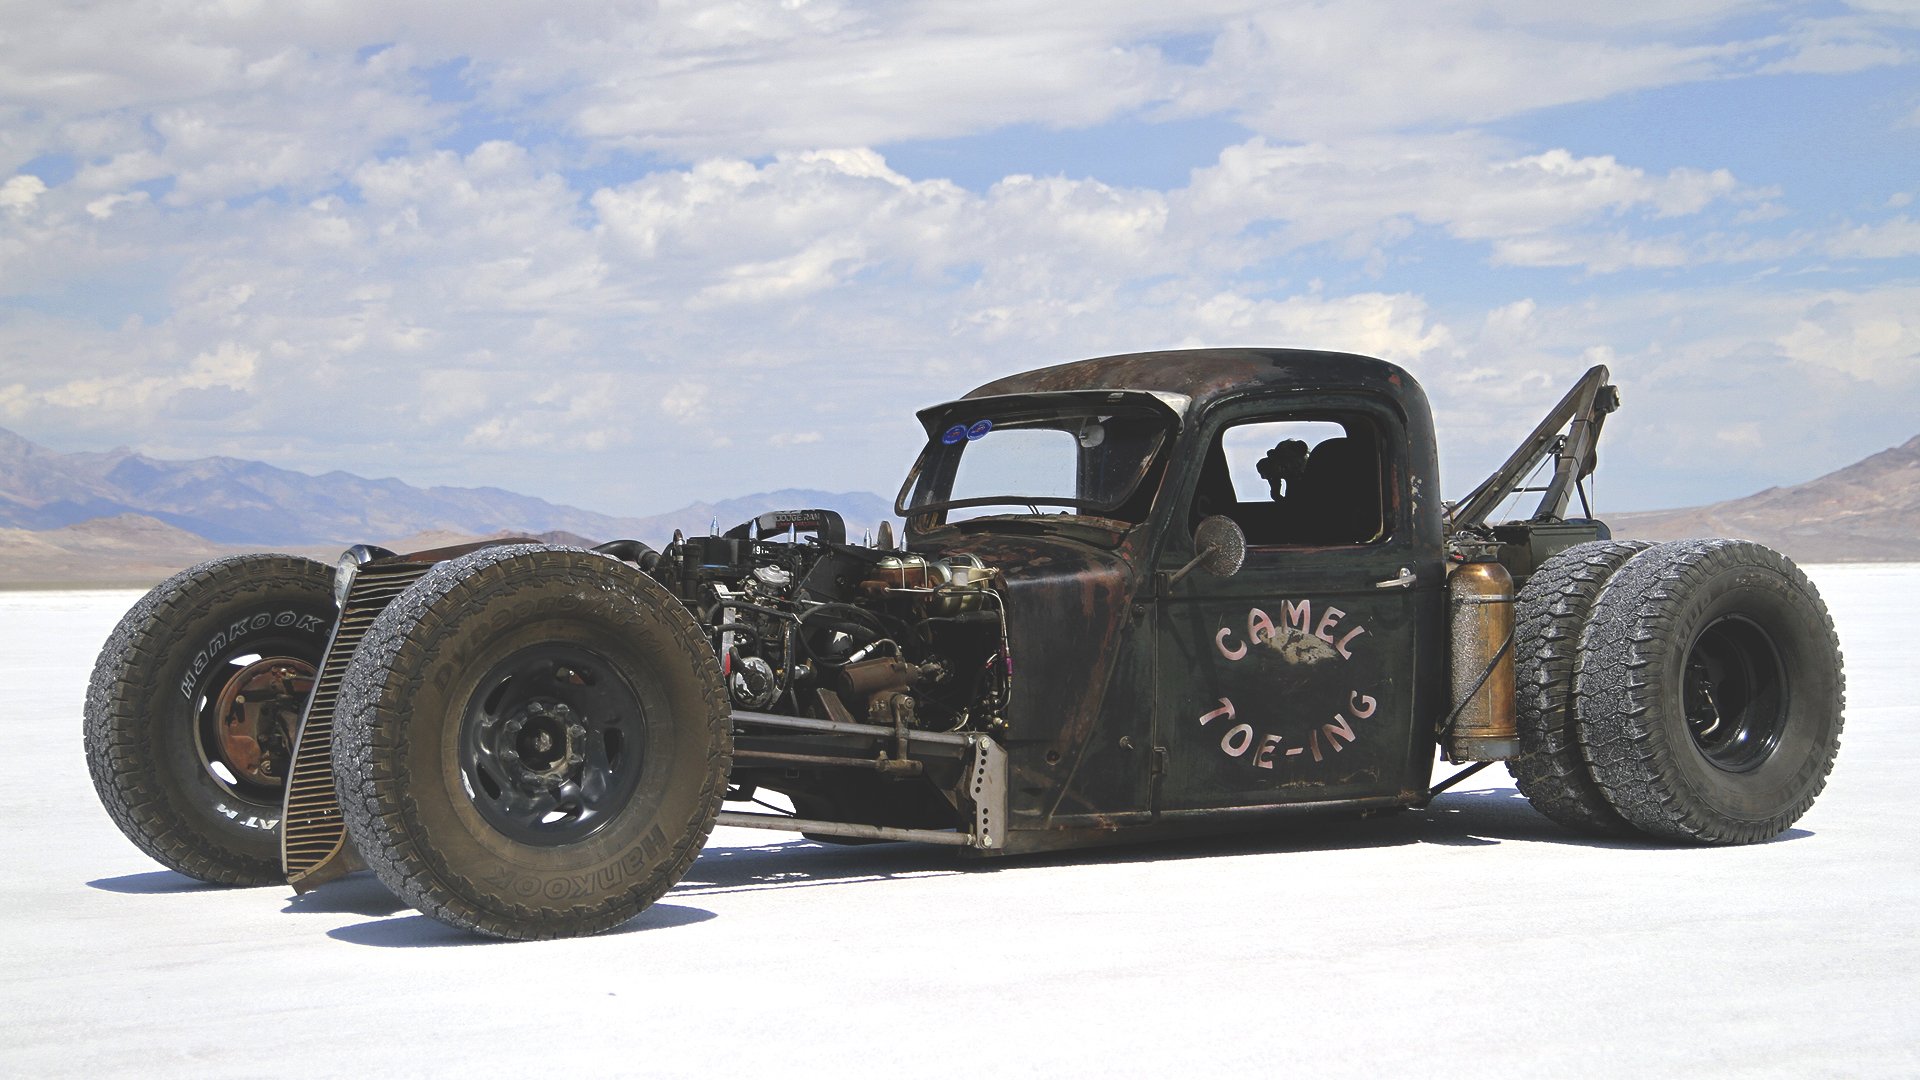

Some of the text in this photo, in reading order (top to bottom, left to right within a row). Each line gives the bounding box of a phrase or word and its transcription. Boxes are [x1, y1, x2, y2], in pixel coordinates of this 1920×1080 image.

[776, 513, 820, 522] DODGE RAM
[180, 611, 325, 700] Hankook
[1215, 600, 1365, 661] CAMEL
[1199, 690, 1377, 770] TOE-ING
[481, 823, 669, 900] Hankook
